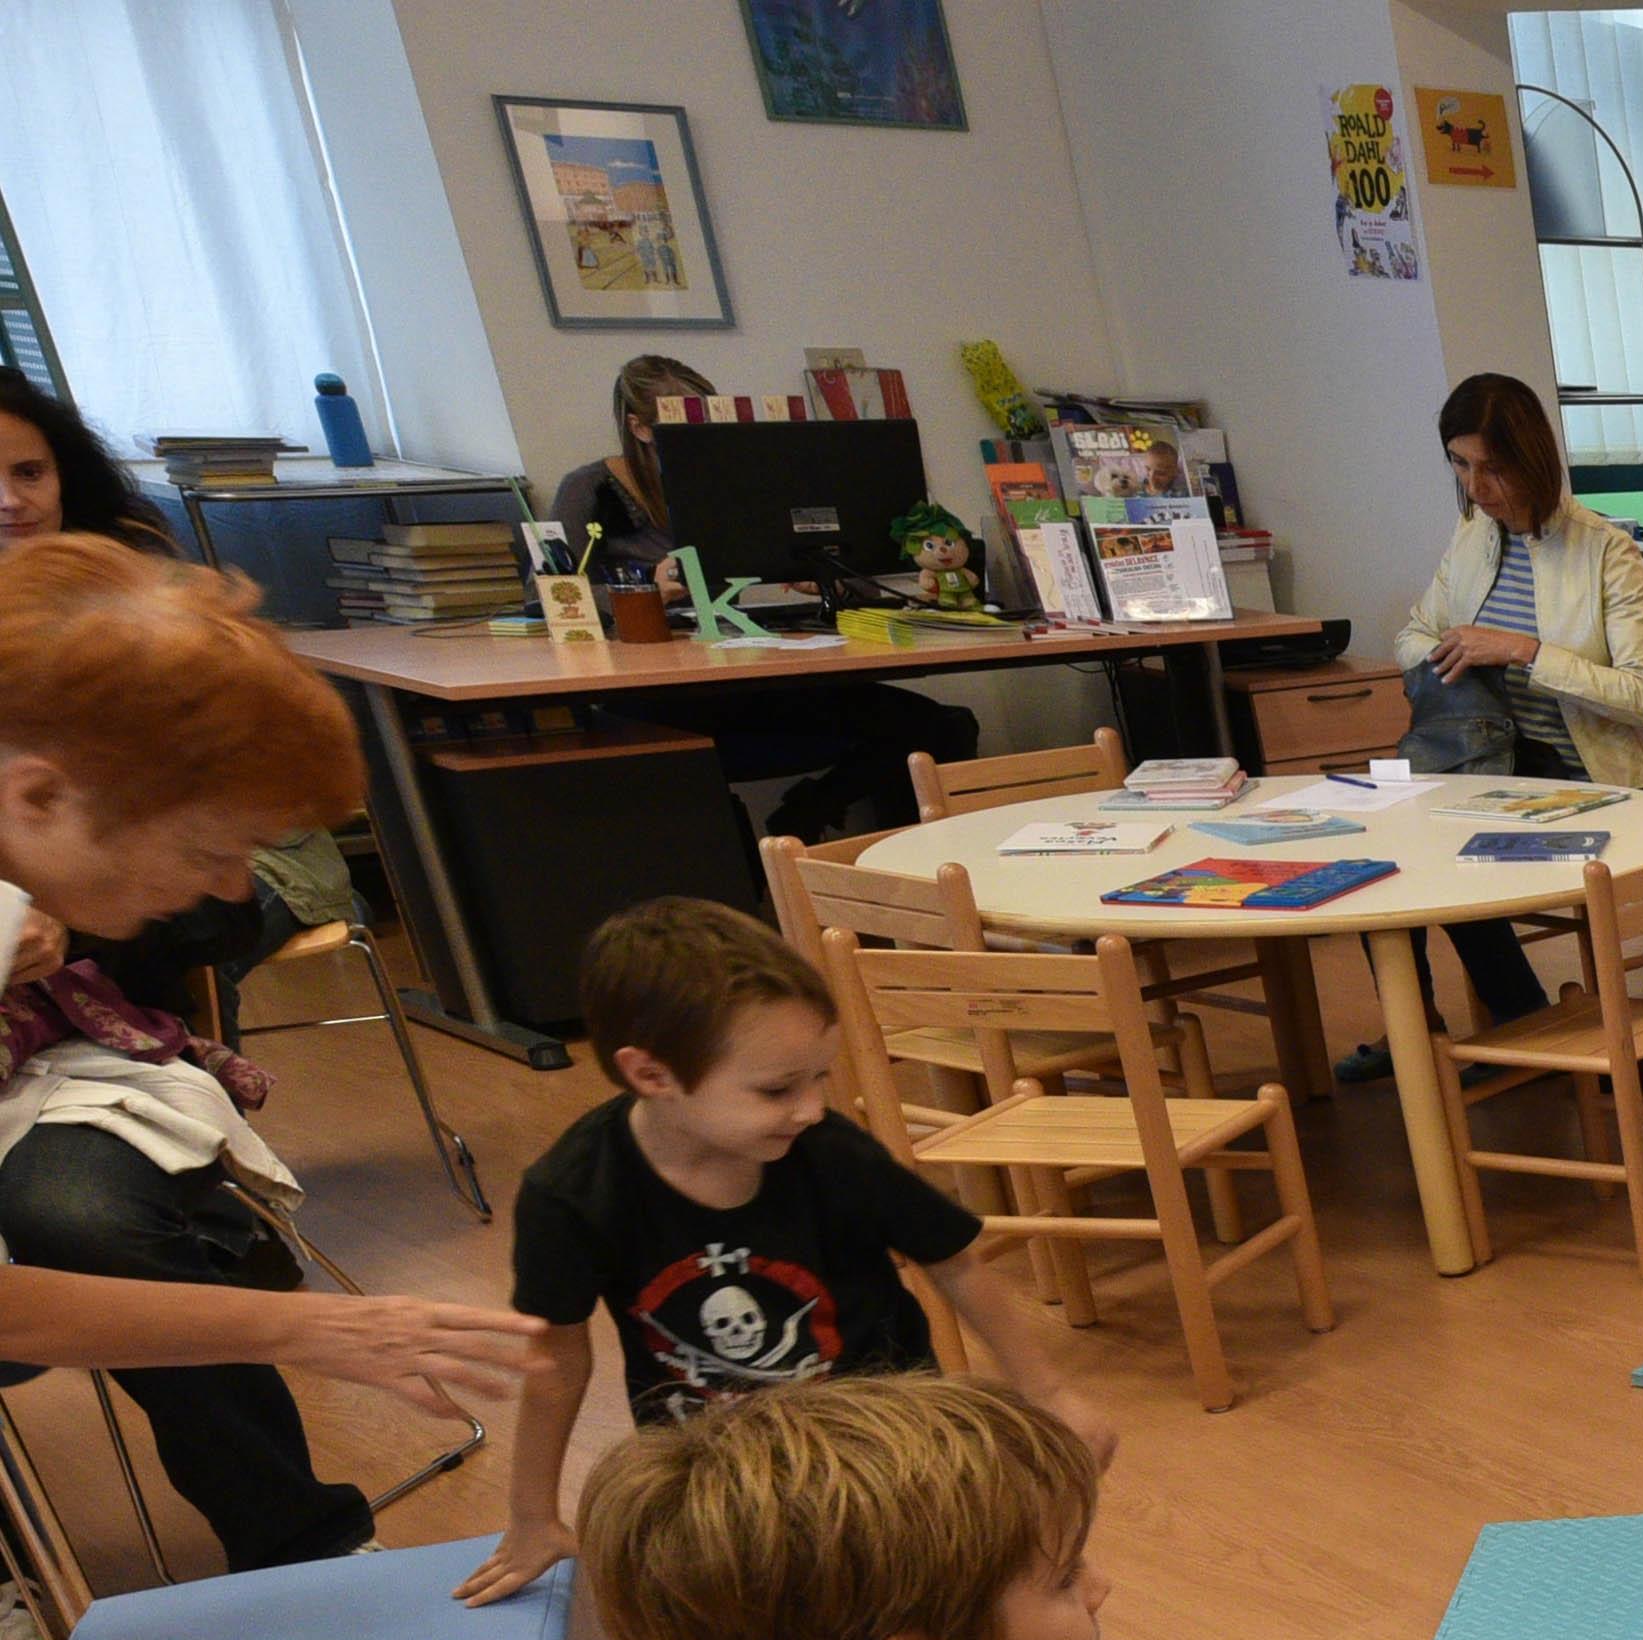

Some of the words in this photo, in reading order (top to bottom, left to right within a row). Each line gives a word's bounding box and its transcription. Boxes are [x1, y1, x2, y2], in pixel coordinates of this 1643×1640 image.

[1338, 113, 1387, 139] ROALD
[1344, 140, 1387, 165] DAHL
[1349, 166, 1391, 209] 100
